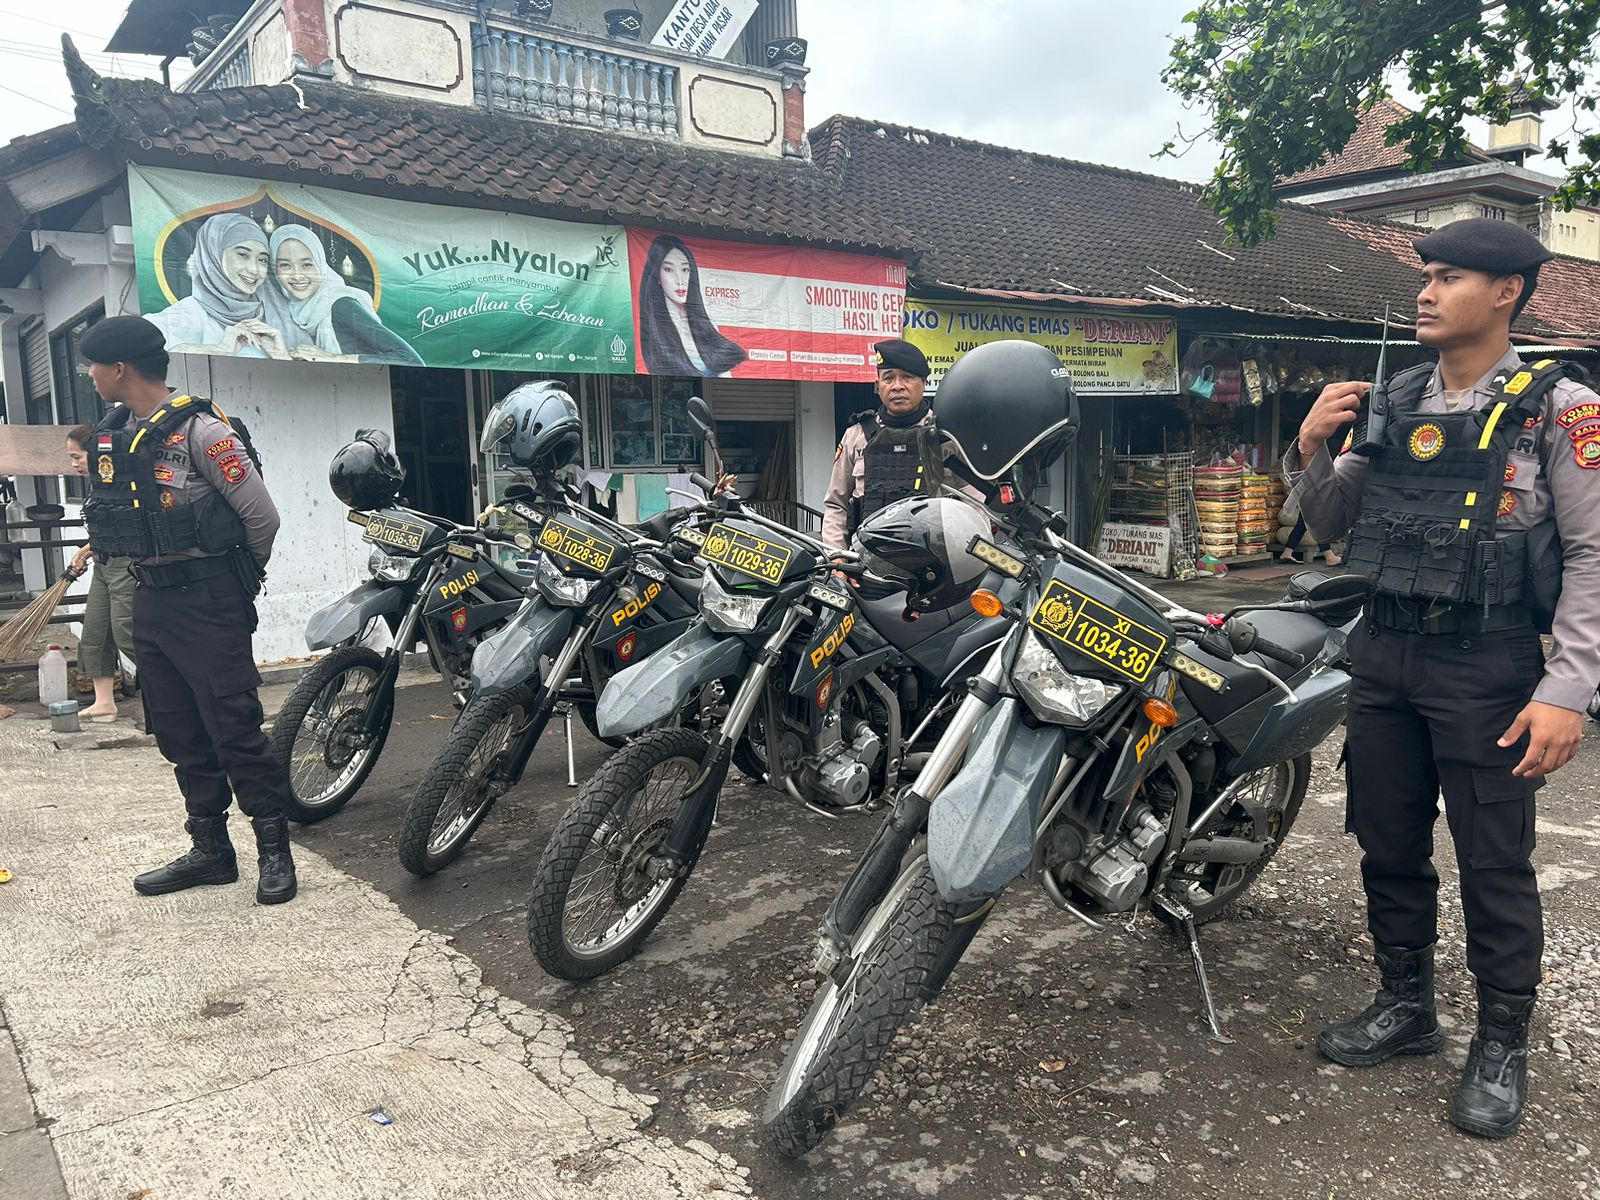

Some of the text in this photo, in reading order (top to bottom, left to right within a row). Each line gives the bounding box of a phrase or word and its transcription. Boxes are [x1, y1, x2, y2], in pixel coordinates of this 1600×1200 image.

[690, 14, 709, 38] DESA
[712, 6, 733, 35] PASAR
[447, 273, 559, 293] Tampil cantik menyambut
[705, 286, 740, 299] EXPRESS
[805, 285, 878, 311] SMOOTHING
[416, 292, 605, 331] Ramadhan & Lebaran
[842, 311, 878, 332] HASIL
[958, 312, 1025, 333] TUKANG
[1028, 315, 1070, 335] EMAS
[1065, 346, 1123, 357] PESIMPENAN
[1073, 380, 1096, 388] BOLONG
[1561, 405, 1599, 422] POLRES
[1575, 425, 1598, 435] BALI
[155, 450, 187, 465] OLRI
[583, 537, 595, 546] XI
[1102, 528, 1118, 537] TOKO
[1123, 529, 1147, 539] TUKANG
[1149, 532, 1163, 540] MAS
[562, 540, 607, 569] 1028-36
[754, 541, 766, 552] XI
[730, 548, 781, 578] 1029-36
[1143, 557, 1161, 565] KAPAL
[439, 569, 480, 600] POLISI
[611, 582, 662, 627] POLISI
[1113, 618, 1131, 634] XI
[809, 612, 855, 669] POLISI
[1075, 621, 1150, 673] 1034-36
